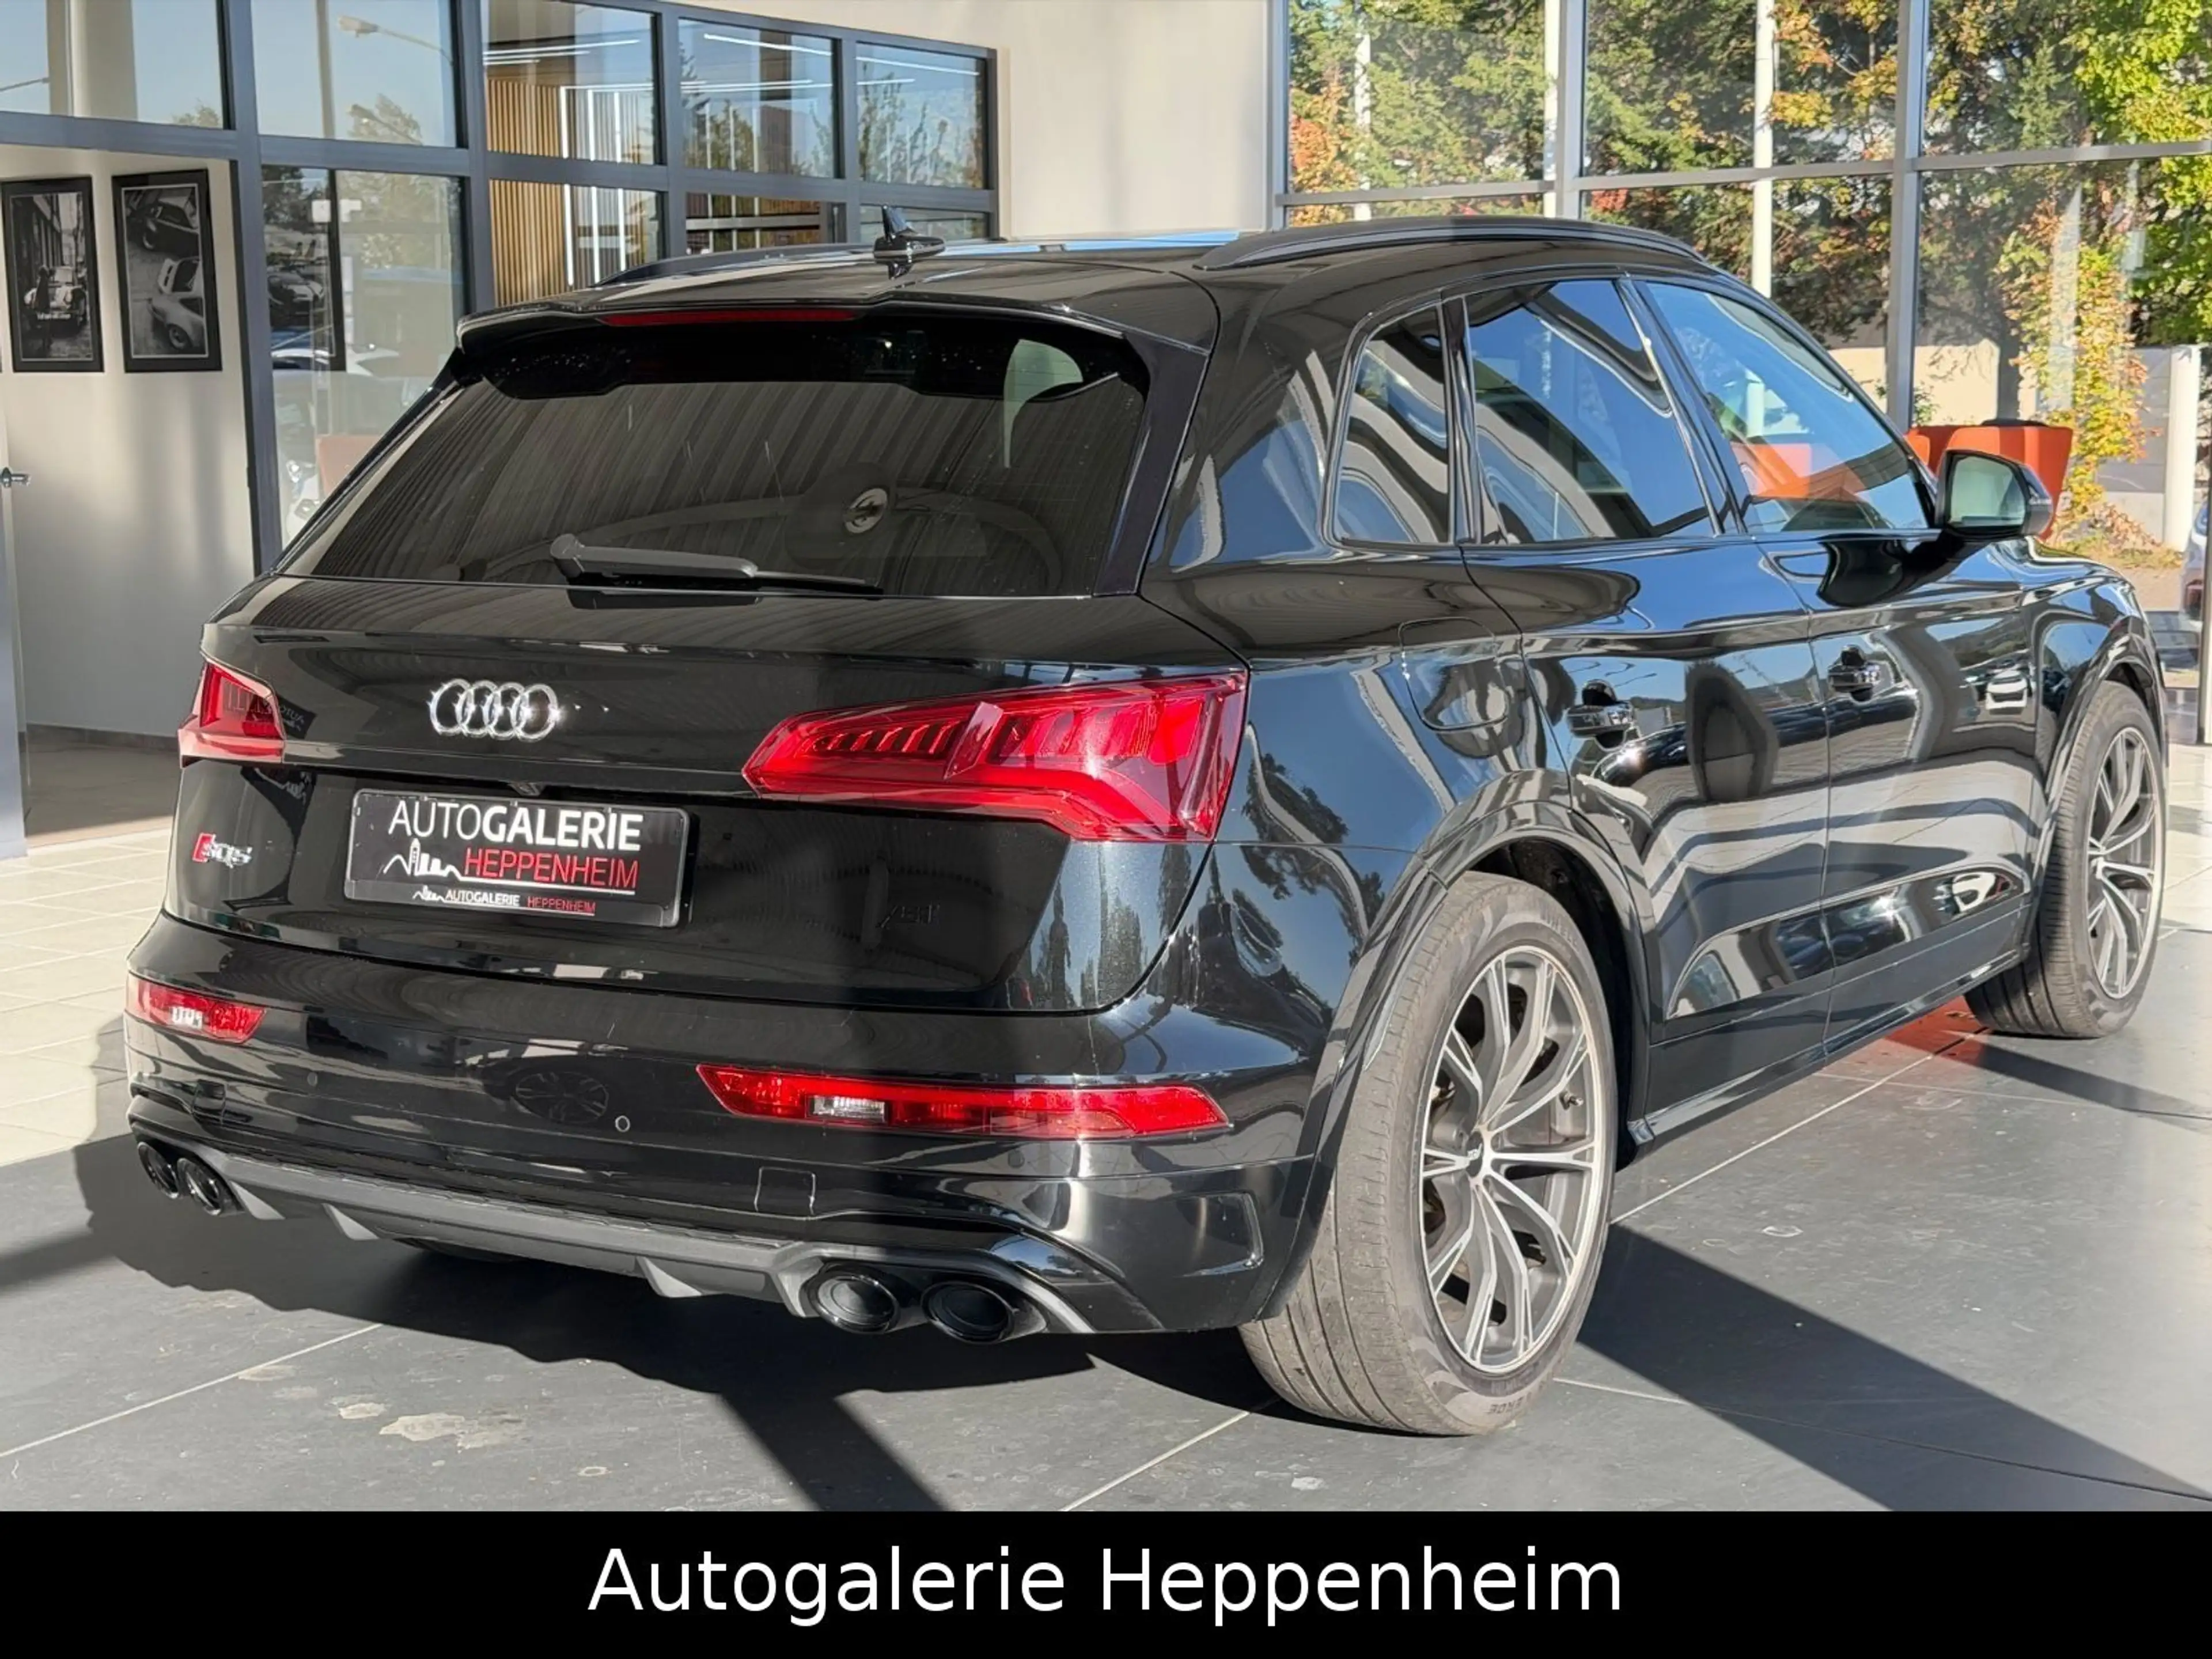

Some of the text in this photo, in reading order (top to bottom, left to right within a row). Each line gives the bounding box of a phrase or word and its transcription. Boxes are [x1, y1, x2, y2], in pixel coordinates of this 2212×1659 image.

[388, 800, 643, 851] AUTOGALERIE
[464, 847, 639, 889] HEPPENHEIM
[445, 889, 596, 912] AUTOGALERIE HEPPENHEIM
